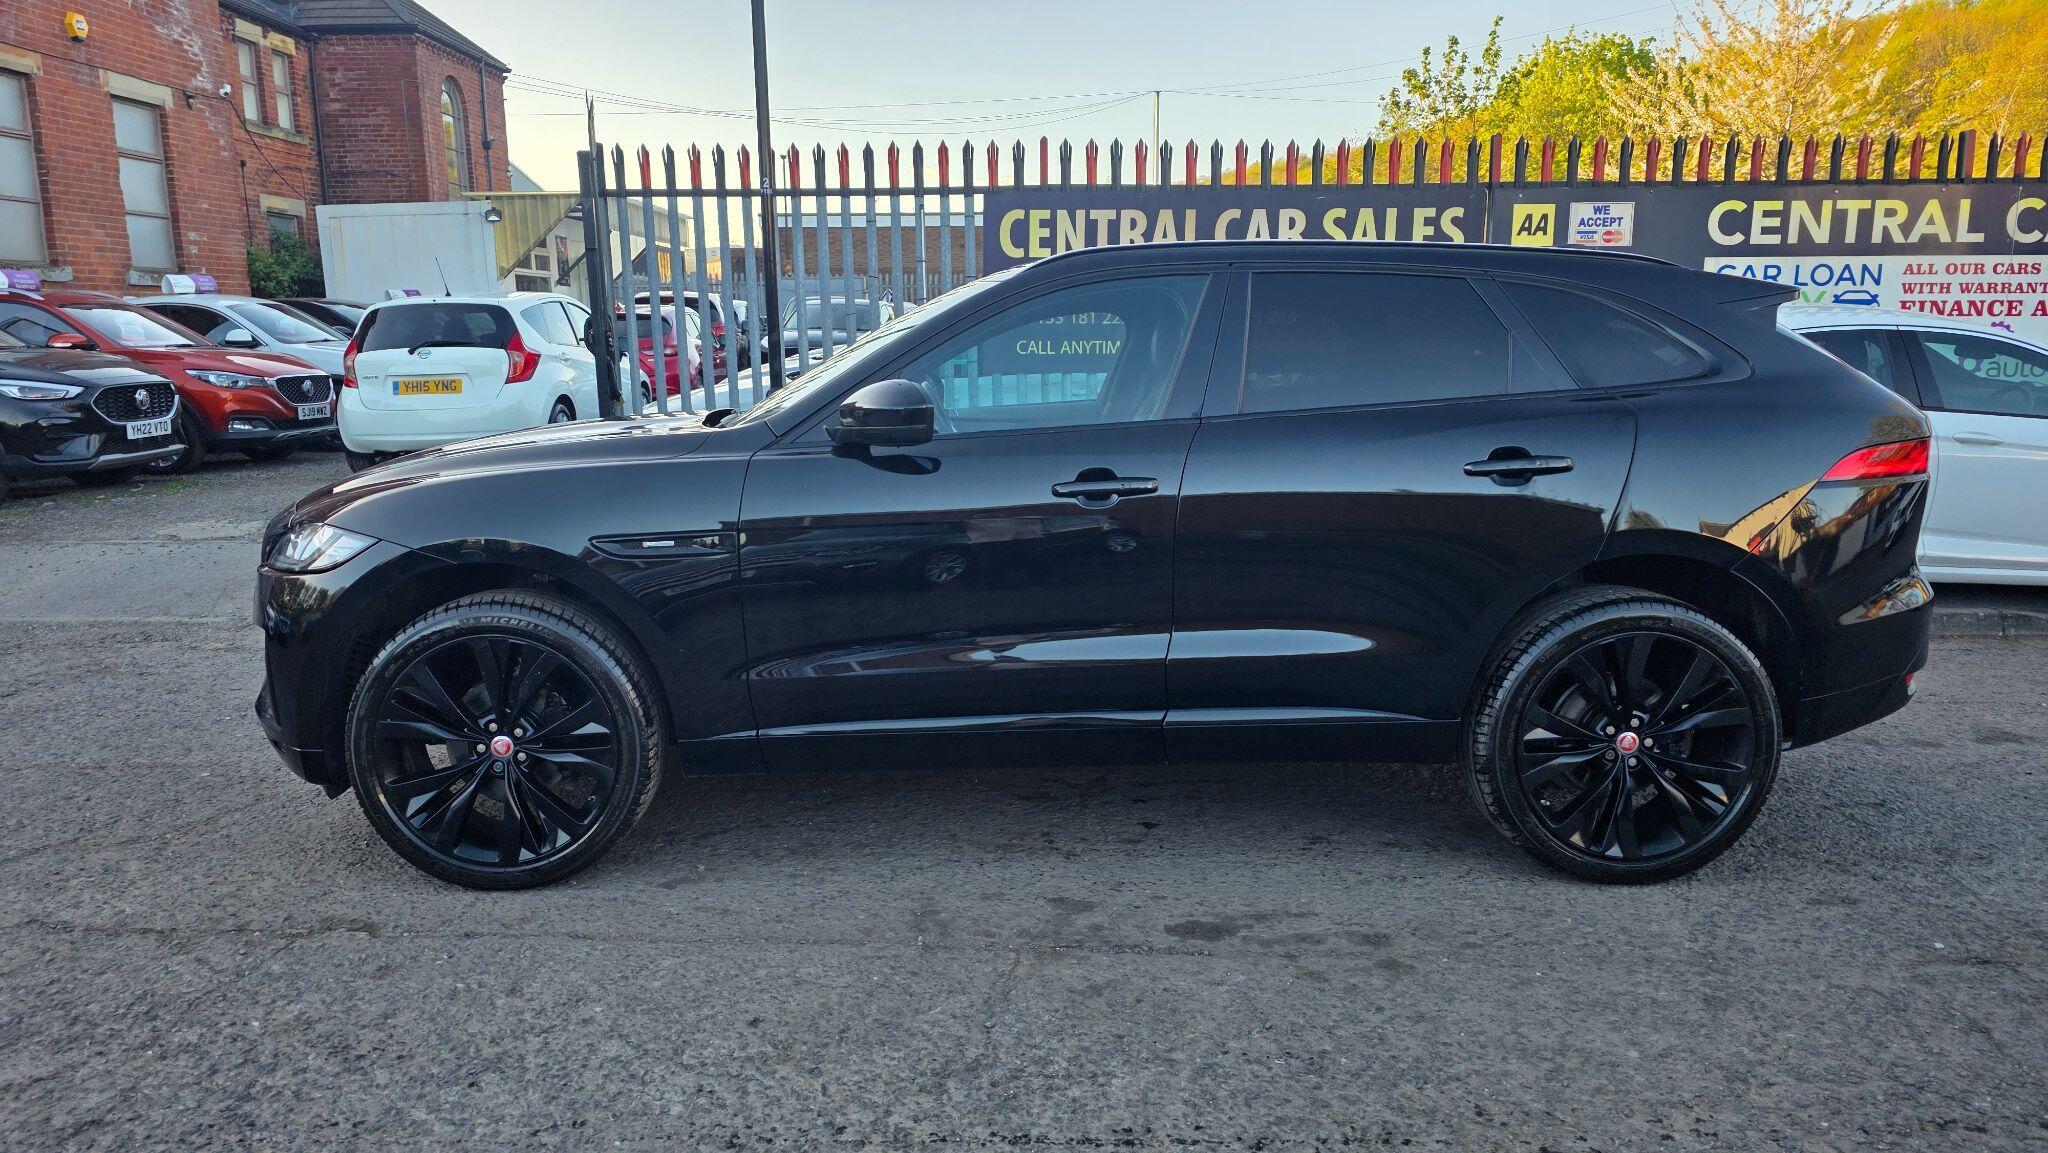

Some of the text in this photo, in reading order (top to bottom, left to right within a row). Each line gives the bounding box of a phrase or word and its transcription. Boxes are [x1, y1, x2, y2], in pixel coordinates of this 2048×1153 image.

[763, 178, 770, 187] 2
[1592, 205, 1611, 215] WE
[1214, 208, 1307, 241] CAR
[1322, 206, 1465, 243] SALES
[1516, 213, 1549, 236] AA
[1577, 217, 1624, 228] ACCEPT
[1707, 197, 2048, 245] CENTRAL C
[1902, 262, 2042, 275] ALL OUR CARS
[1793, 264, 1883, 287] LOAN
[1901, 282, 1952, 294] WITH
[1899, 300, 2024, 317] FINANCE
[1102, 312, 1124, 324] 22
[1016, 340, 1056, 355] CALL
[403, 380, 457, 392] YH15 YNG
[301, 406, 316, 418] SJ19
[131, 421, 168, 436] YH22 VTO
